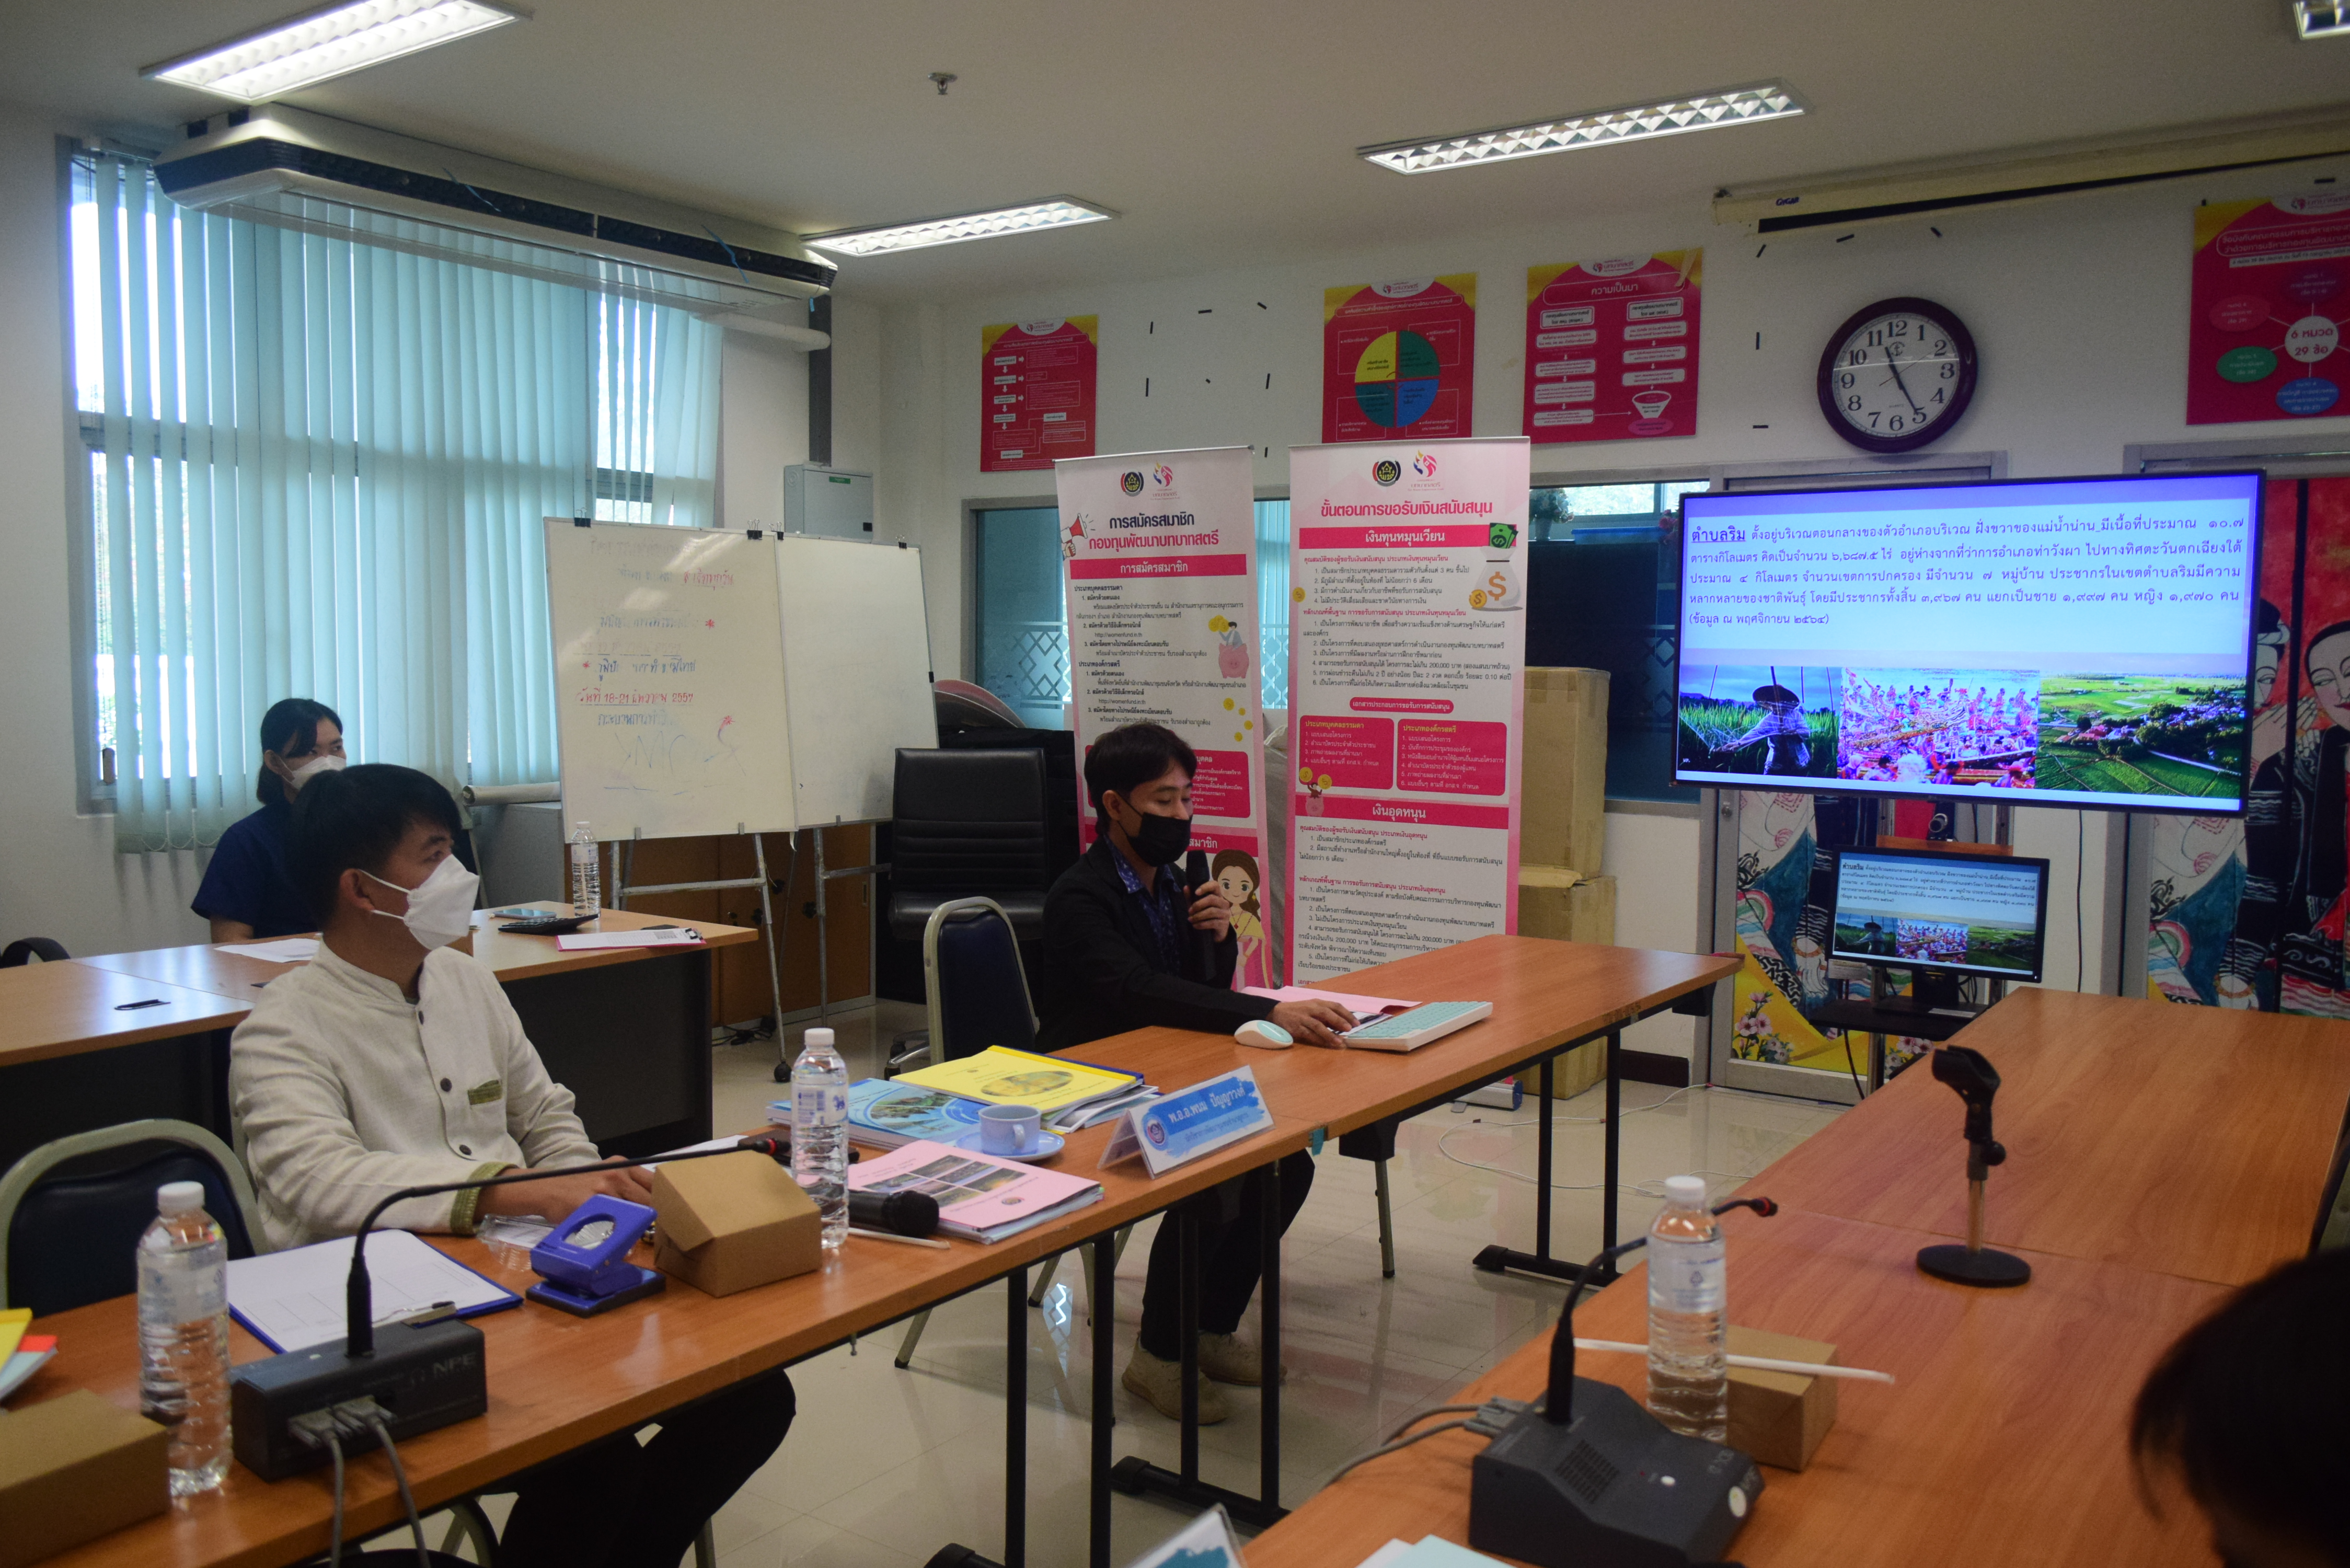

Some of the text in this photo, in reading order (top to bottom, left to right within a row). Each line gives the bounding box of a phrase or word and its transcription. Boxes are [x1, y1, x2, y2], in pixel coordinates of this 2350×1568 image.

[1591, 282, 1638, 296] ความเป็นมา
[1886, 320, 1907, 338] 12
[1918, 325, 1926, 341] 1
[2291, 327, 2333, 339] 6 หมวด
[1867, 330, 1883, 347] 11
[1934, 340, 1946, 356] 2
[2295, 343, 2329, 356] 29 ข้อ
[1849, 349, 1867, 366] 10
[1940, 363, 1954, 379] 3
[1841, 373, 1855, 388] 9
[1848, 395, 1861, 411] 8
[1930, 387, 1944, 403] 4
[1868, 411, 1881, 428] 7
[1889, 415, 1904, 431] 6
[1912, 407, 1927, 424] 5
[1321, 499, 1492, 517] ขั้นตอนการขอรับเงินสนับสนุน
[1109, 511, 1194, 529] การสมัครสมาชิก
[1365, 528, 1445, 546] เงินทุนหมุนเวียน
[1692, 525, 1745, 543] ตำบลริม
[1752, 523, 1970, 543] ตั้งอยู่บริเวณตอนกลางของตัวอำเภอบริเวณ
[2209, 518, 2244, 528] ๑๐.๗
[1089, 529, 1219, 552] กองทุนพัฒนาบทบาทสตรี
[1691, 539, 2242, 563] ตารางกิโลเมตร คิดเป็นจำนวน ๖,๖๘๗.๕ ไร่ อยู่ห่างจากที่ว่าการอำเภอท่าวังผา ไปทางทิศตะวันตกเฉียงใต้
[1120, 560, 1188, 573] การสมัครสมาชิก
[1690, 573, 1731, 583] ประมาณ
[1755, 570, 1798, 582] กิโลเมตร
[1802, 570, 1920, 582] จำนวนเขตการปกครอง
[1926, 568, 1973, 580] มีจำนวน
[1983, 571, 1992, 580] ๗
[2001, 566, 2044, 584] หมู่บ้าน
[2049, 563, 2240, 579] ประชากรในเขตตำบลริมมีความ
[1689, 586, 2239, 606] หลากหลายของชาติพันธุ์ โดยมีประชากรทั้งสิ้น ๓,๙๖๗ คน แยกเป็นชาย ๑,๙๙๗ คน หญิง ๑,๙๗๐ คน
[1689, 612, 1719, 627] (ข้อมูล
[1736, 612, 1790, 625] พฤศจิกายน
[1794, 614, 1829, 624] ๒๕๖๔)
[1373, 803, 1426, 822] เงินอุดหนุน
